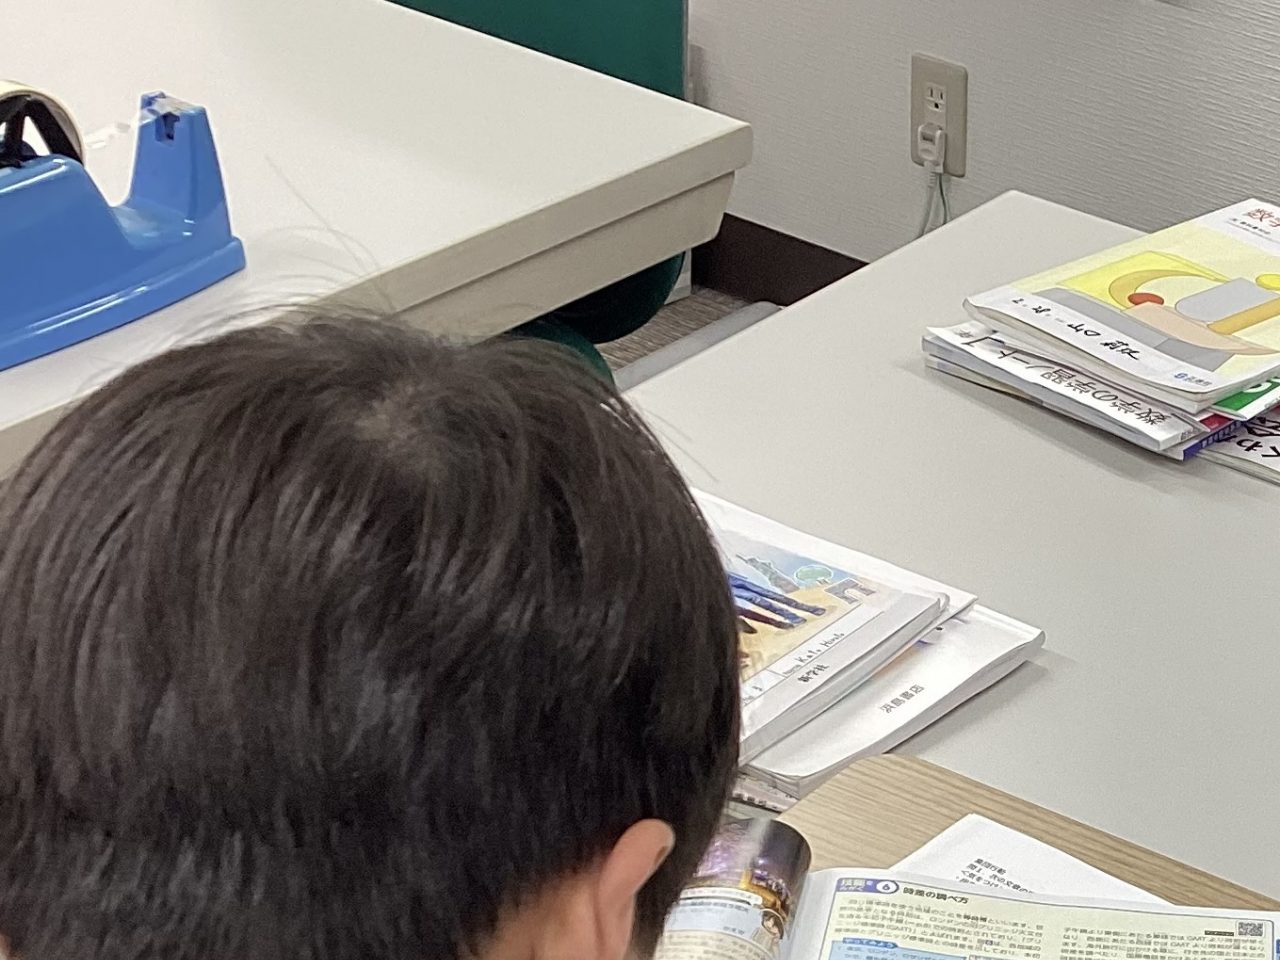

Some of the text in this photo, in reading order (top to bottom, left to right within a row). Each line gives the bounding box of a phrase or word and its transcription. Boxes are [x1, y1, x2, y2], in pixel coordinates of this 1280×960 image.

[997, 349, 1170, 425] 数学の学習ノート
[903, 887, 969, 904] 時差の調べ方
